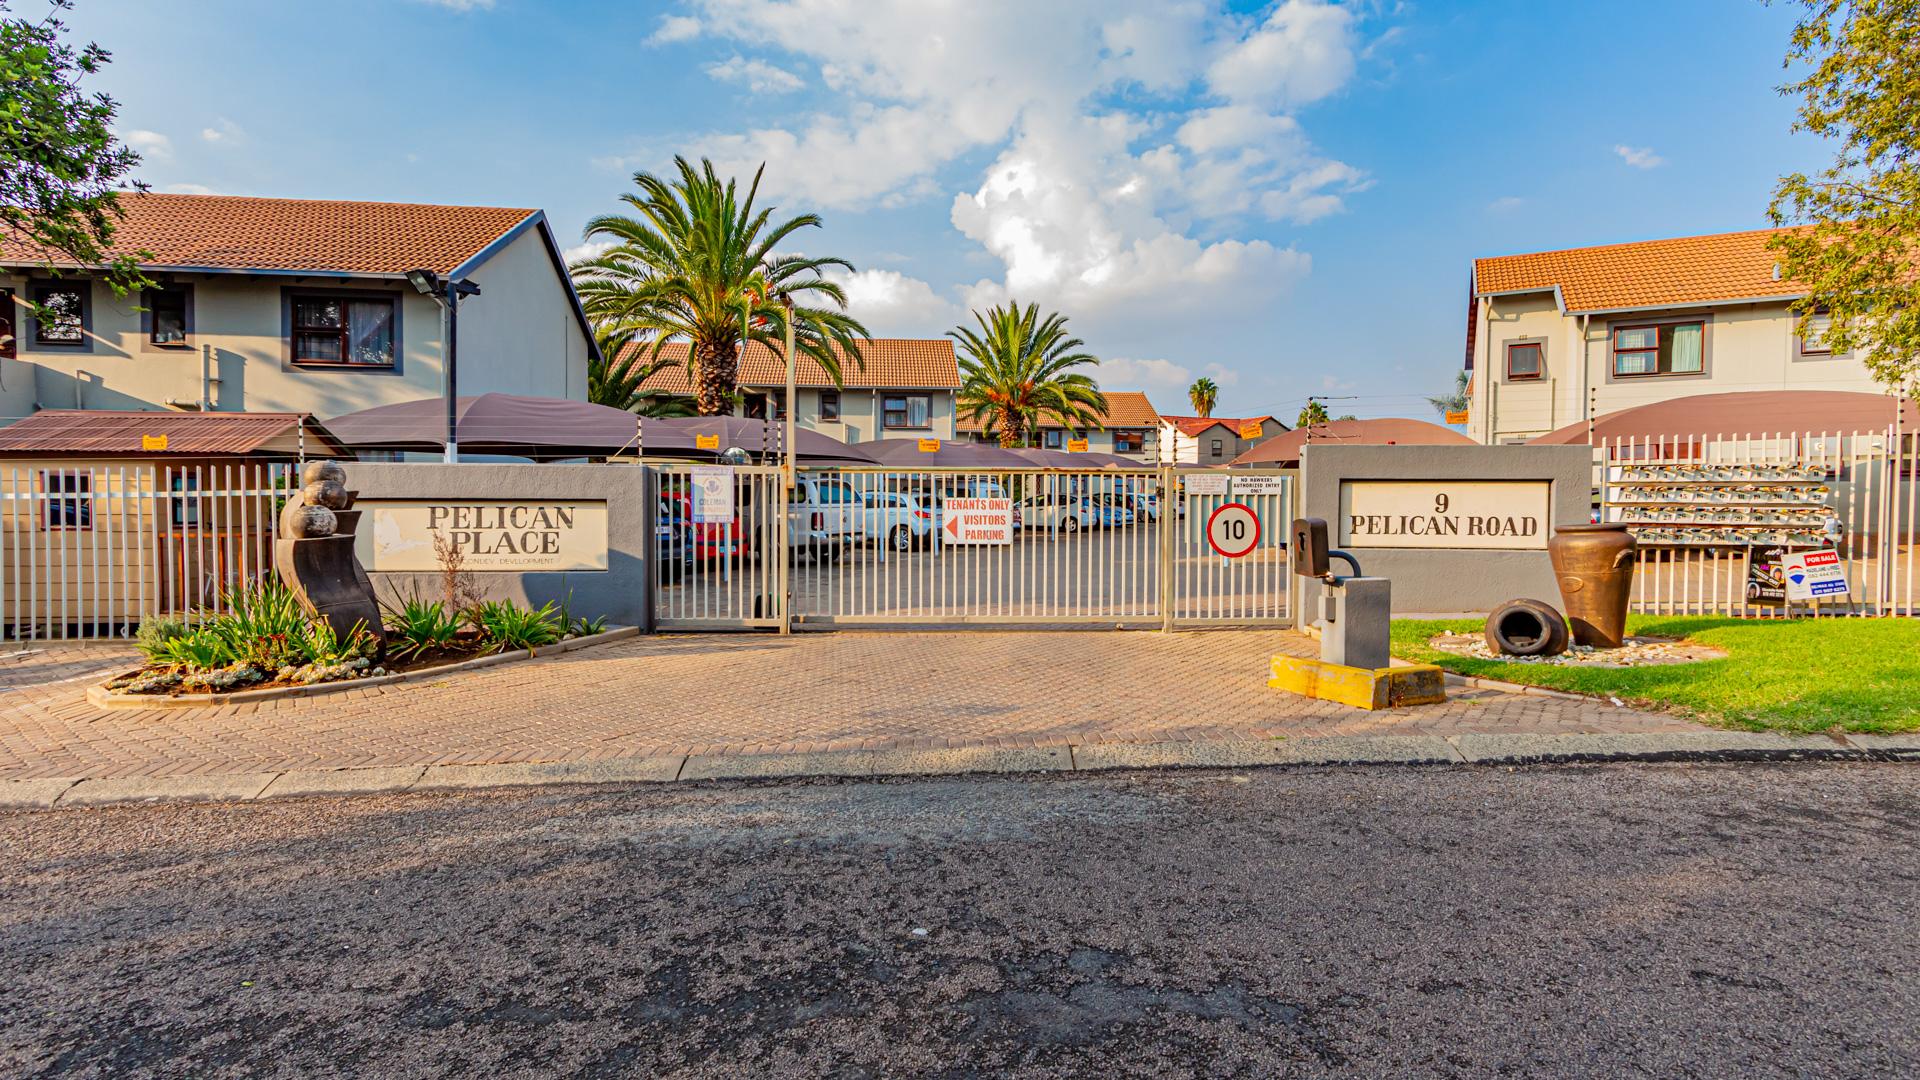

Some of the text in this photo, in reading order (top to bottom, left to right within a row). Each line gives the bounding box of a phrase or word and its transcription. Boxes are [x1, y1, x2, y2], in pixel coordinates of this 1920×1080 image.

[946, 499, 1010, 511] TENANTS ONLY
[1434, 493, 1449, 513] 9
[426, 506, 576, 530] PELICAN
[963, 515, 1006, 525] VISITORS
[1350, 515, 1537, 537] PELICAN ROAD
[964, 530, 1005, 540] PARKING
[1222, 519, 1245, 540] 10
[451, 530, 560, 555] PLACE
[1820, 554, 1836, 562] SALE
